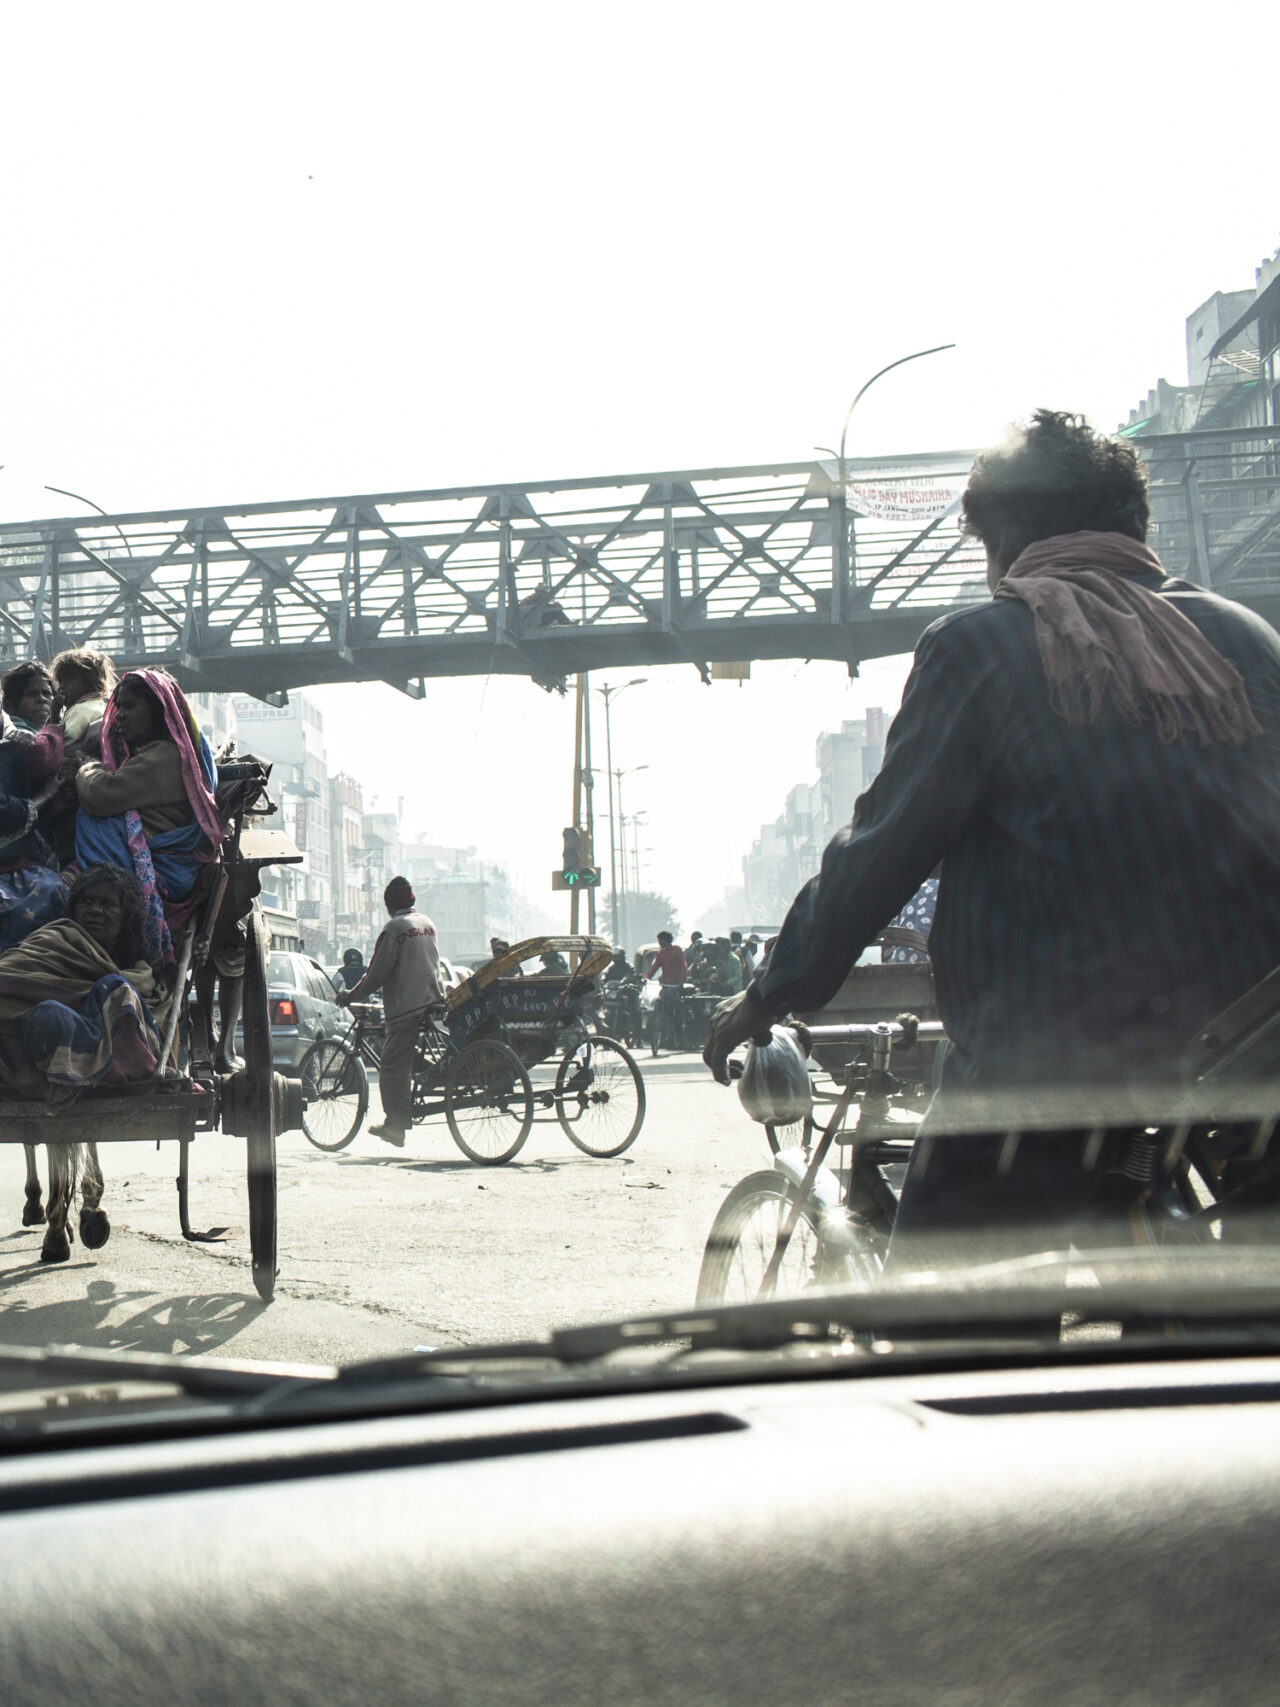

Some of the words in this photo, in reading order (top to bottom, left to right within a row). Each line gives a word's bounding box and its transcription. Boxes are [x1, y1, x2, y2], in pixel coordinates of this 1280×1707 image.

[878, 490, 898, 504] DAY
[899, 489, 953, 505] MUSHAIRA
[296, 804, 306, 845] HOTEL
